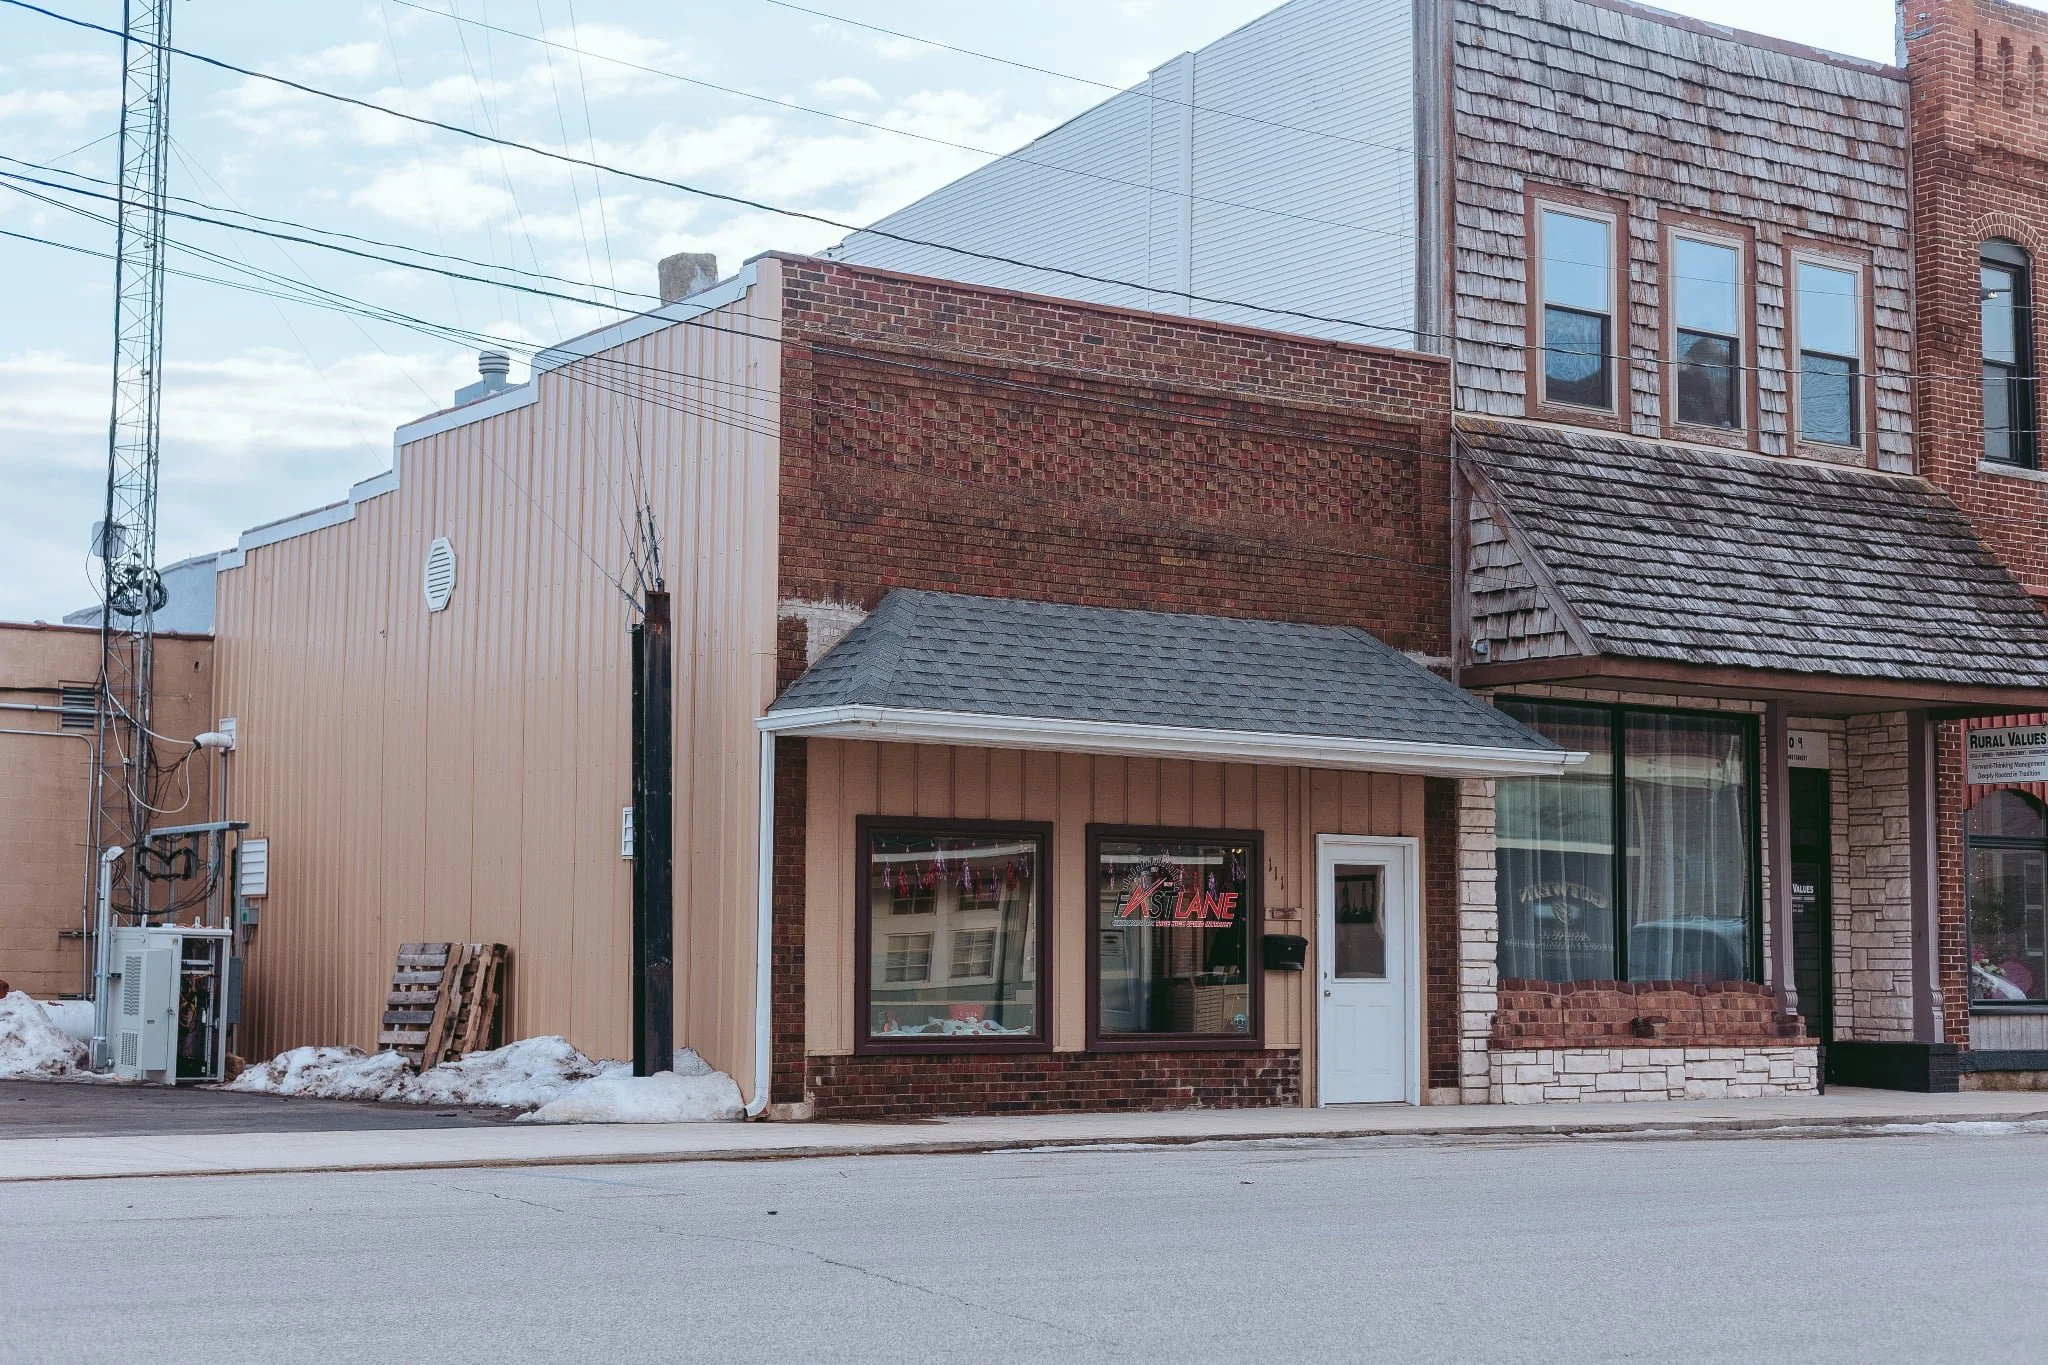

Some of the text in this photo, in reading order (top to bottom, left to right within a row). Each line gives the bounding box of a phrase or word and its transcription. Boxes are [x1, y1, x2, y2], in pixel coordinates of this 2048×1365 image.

[1969, 731, 2047, 749] RURAL VALUES
[1977, 772, 1994, 780] Deeply
[1792, 883, 1814, 894] VALUES
